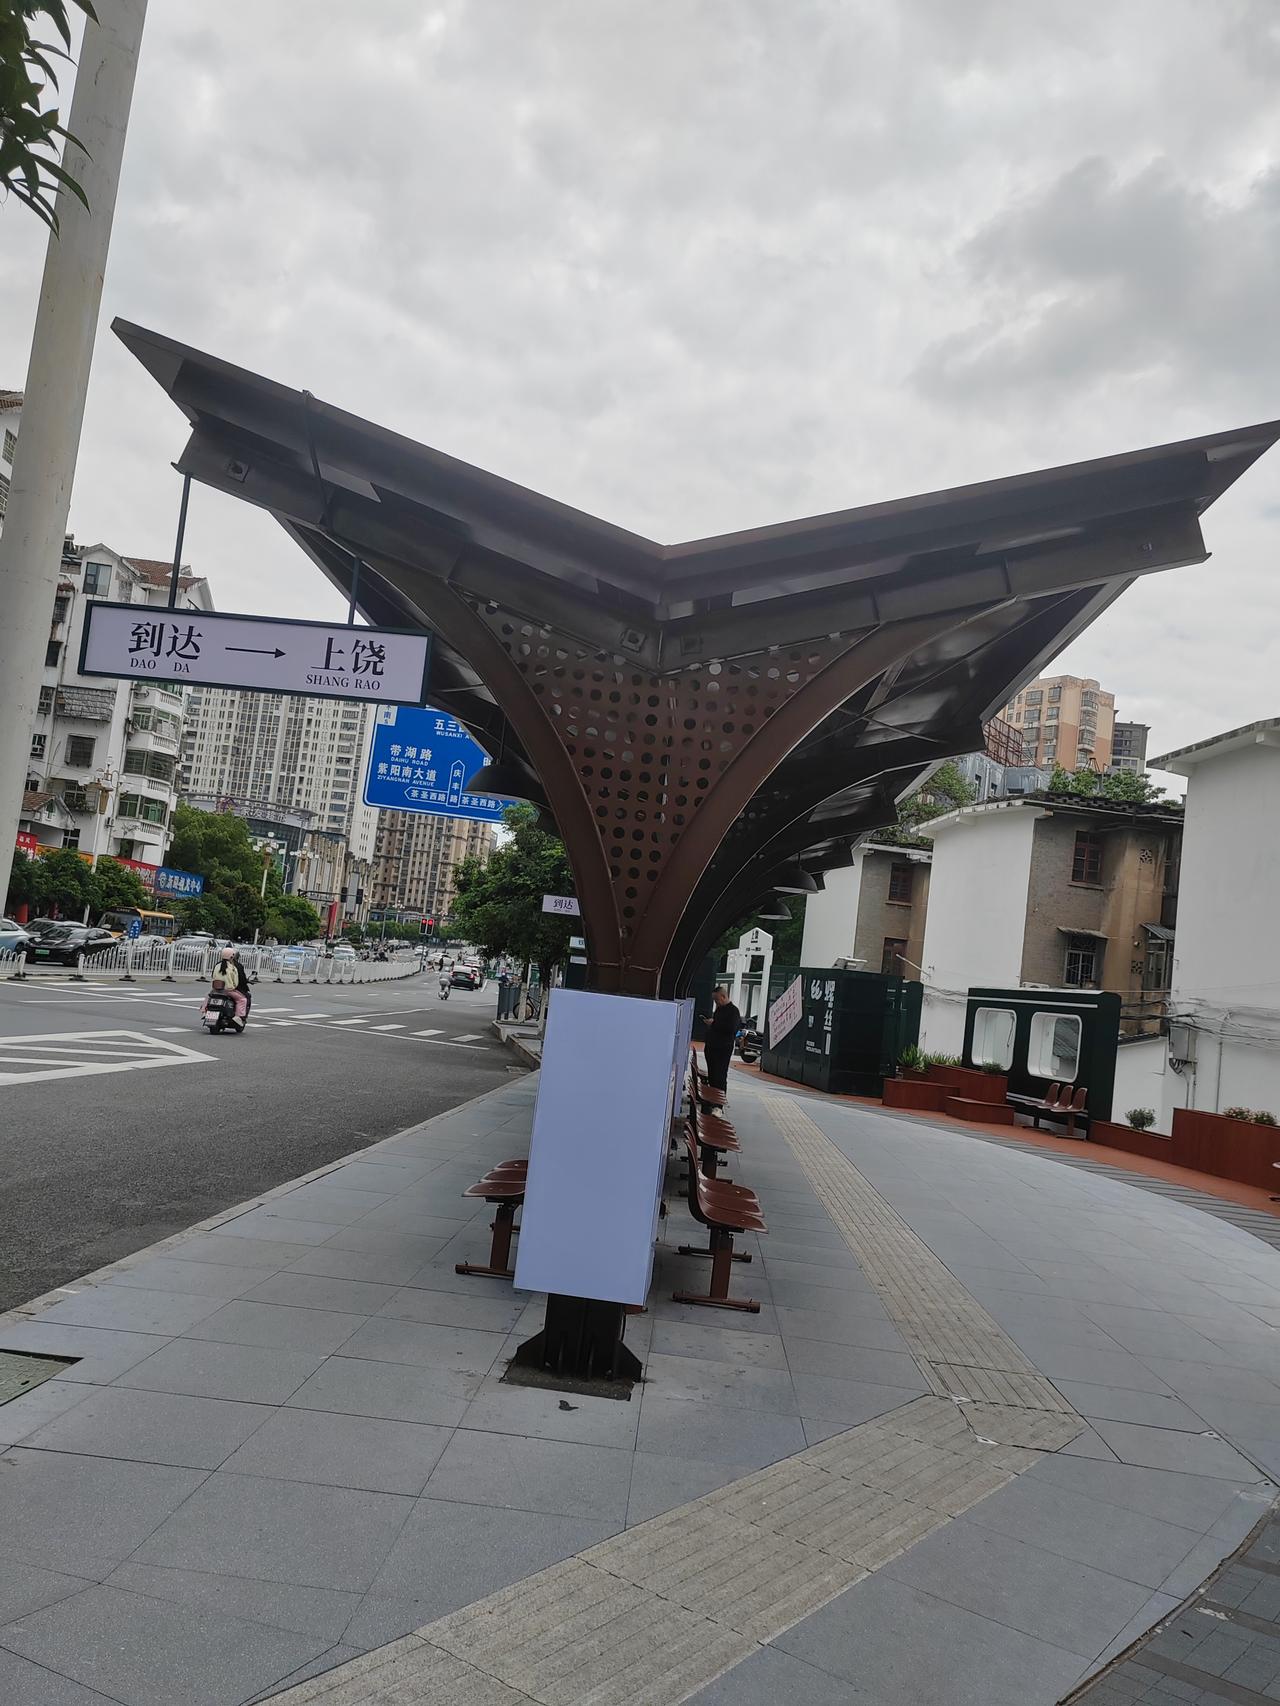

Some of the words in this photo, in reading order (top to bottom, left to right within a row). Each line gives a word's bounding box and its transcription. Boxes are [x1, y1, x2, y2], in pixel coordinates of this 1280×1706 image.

[127, 621, 203, 661] 到达
[310, 636, 386, 676] 上饶
[130, 657, 156, 670] DAO
[173, 661, 191, 674] DA
[305, 673, 350, 689] SHANG
[354, 678, 381, 691] RAO
[390, 744, 432, 761] 带湖路
[390, 756, 410, 764] DAIHU
[412, 759, 429, 767] ROAD
[377, 762, 437, 781] 紫阳南大道
[412, 779, 435, 787] AVENUE
[449, 769, 462, 804] 庆丰路
[411, 790, 446, 802] 茶圣西路
[462, 797, 496, 808] 茶圣西路
[553, 899, 573, 909] 到达
